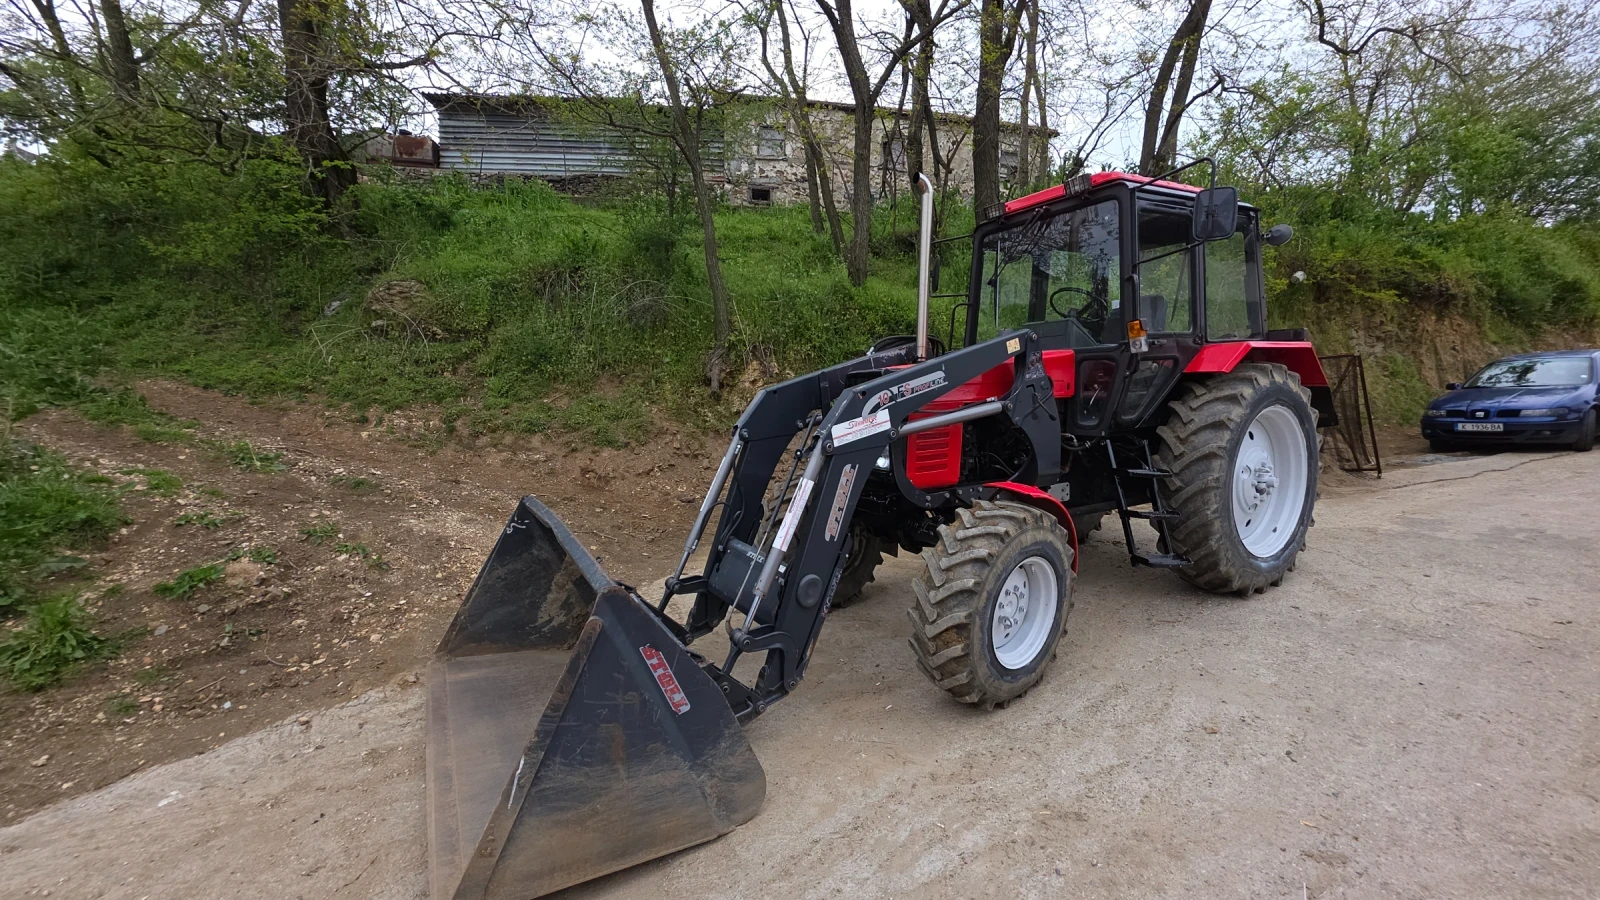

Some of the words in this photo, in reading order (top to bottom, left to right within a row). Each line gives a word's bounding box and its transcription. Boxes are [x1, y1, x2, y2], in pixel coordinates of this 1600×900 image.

[878, 392, 890, 406] 10
[897, 383, 911, 399] FS
[826, 467, 855, 538] STOLL
[640, 646, 689, 714] STOLL
